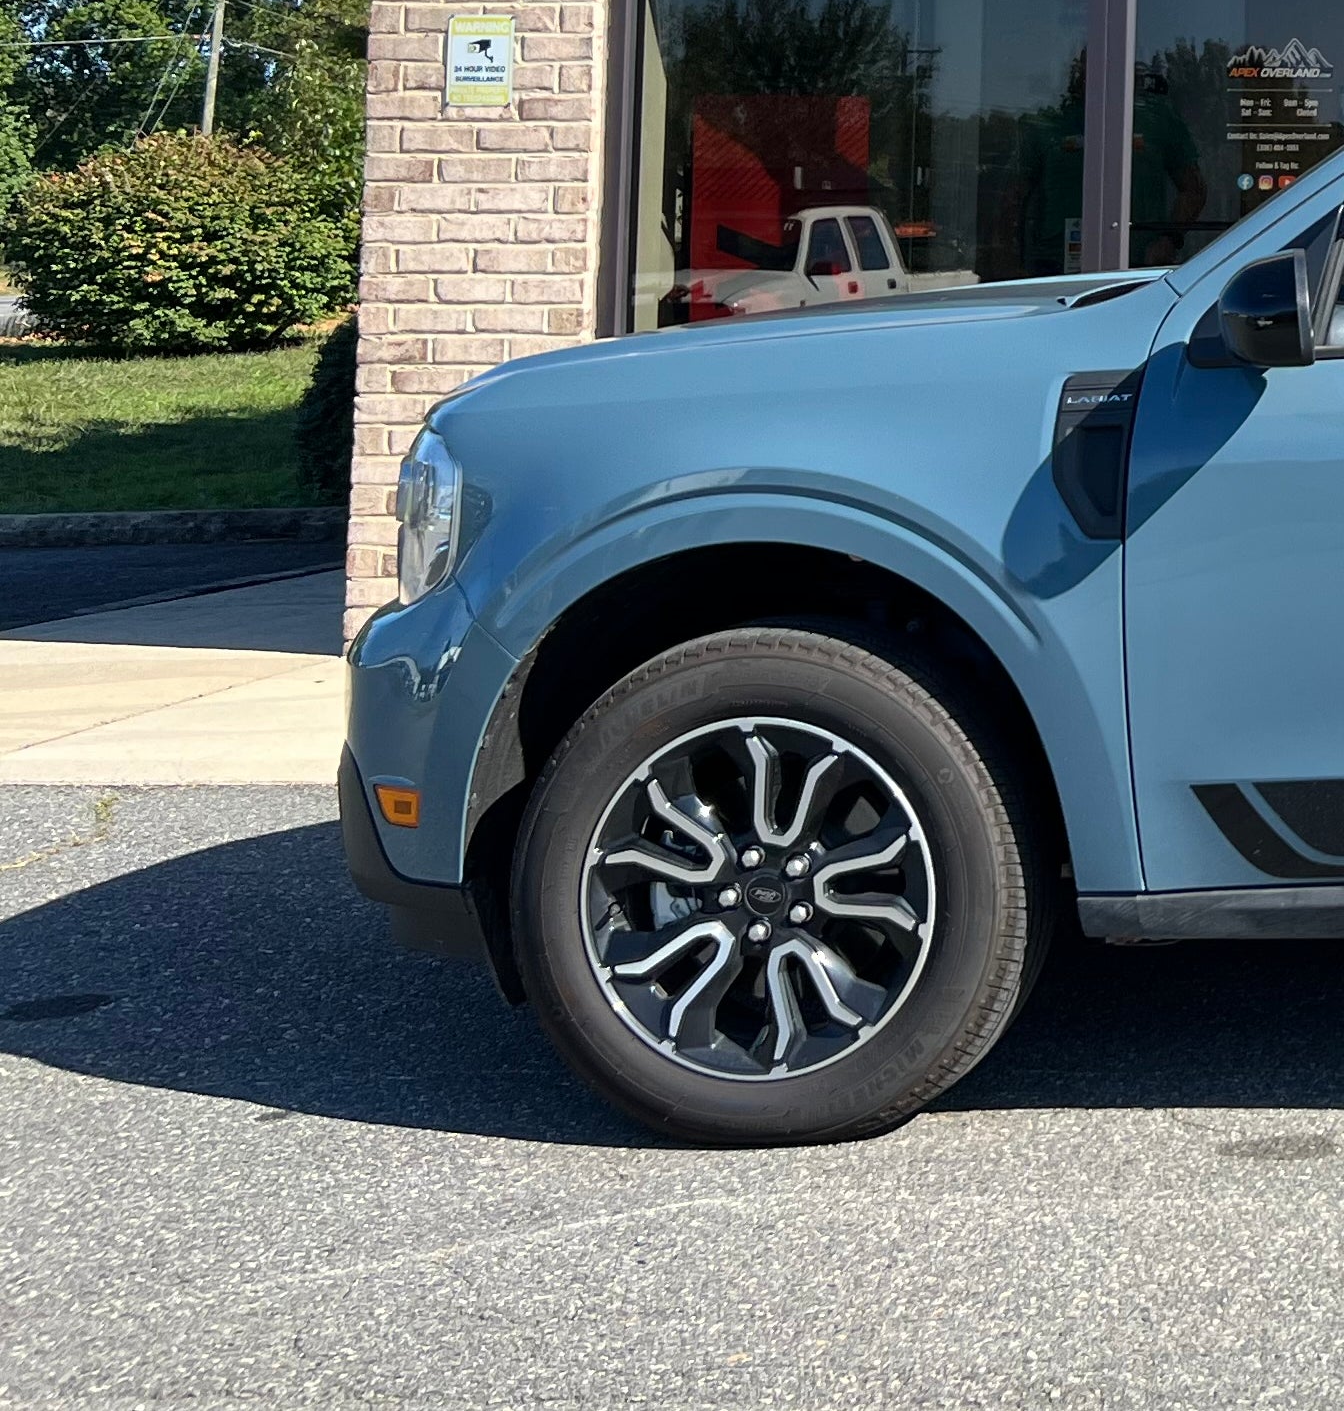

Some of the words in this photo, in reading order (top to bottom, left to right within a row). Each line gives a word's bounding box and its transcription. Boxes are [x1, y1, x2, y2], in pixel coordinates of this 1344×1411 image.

[455, 21, 511, 33] WARNING
[1229, 67, 1261, 78] APEX
[1066, 393, 1133, 405] LARIAT
